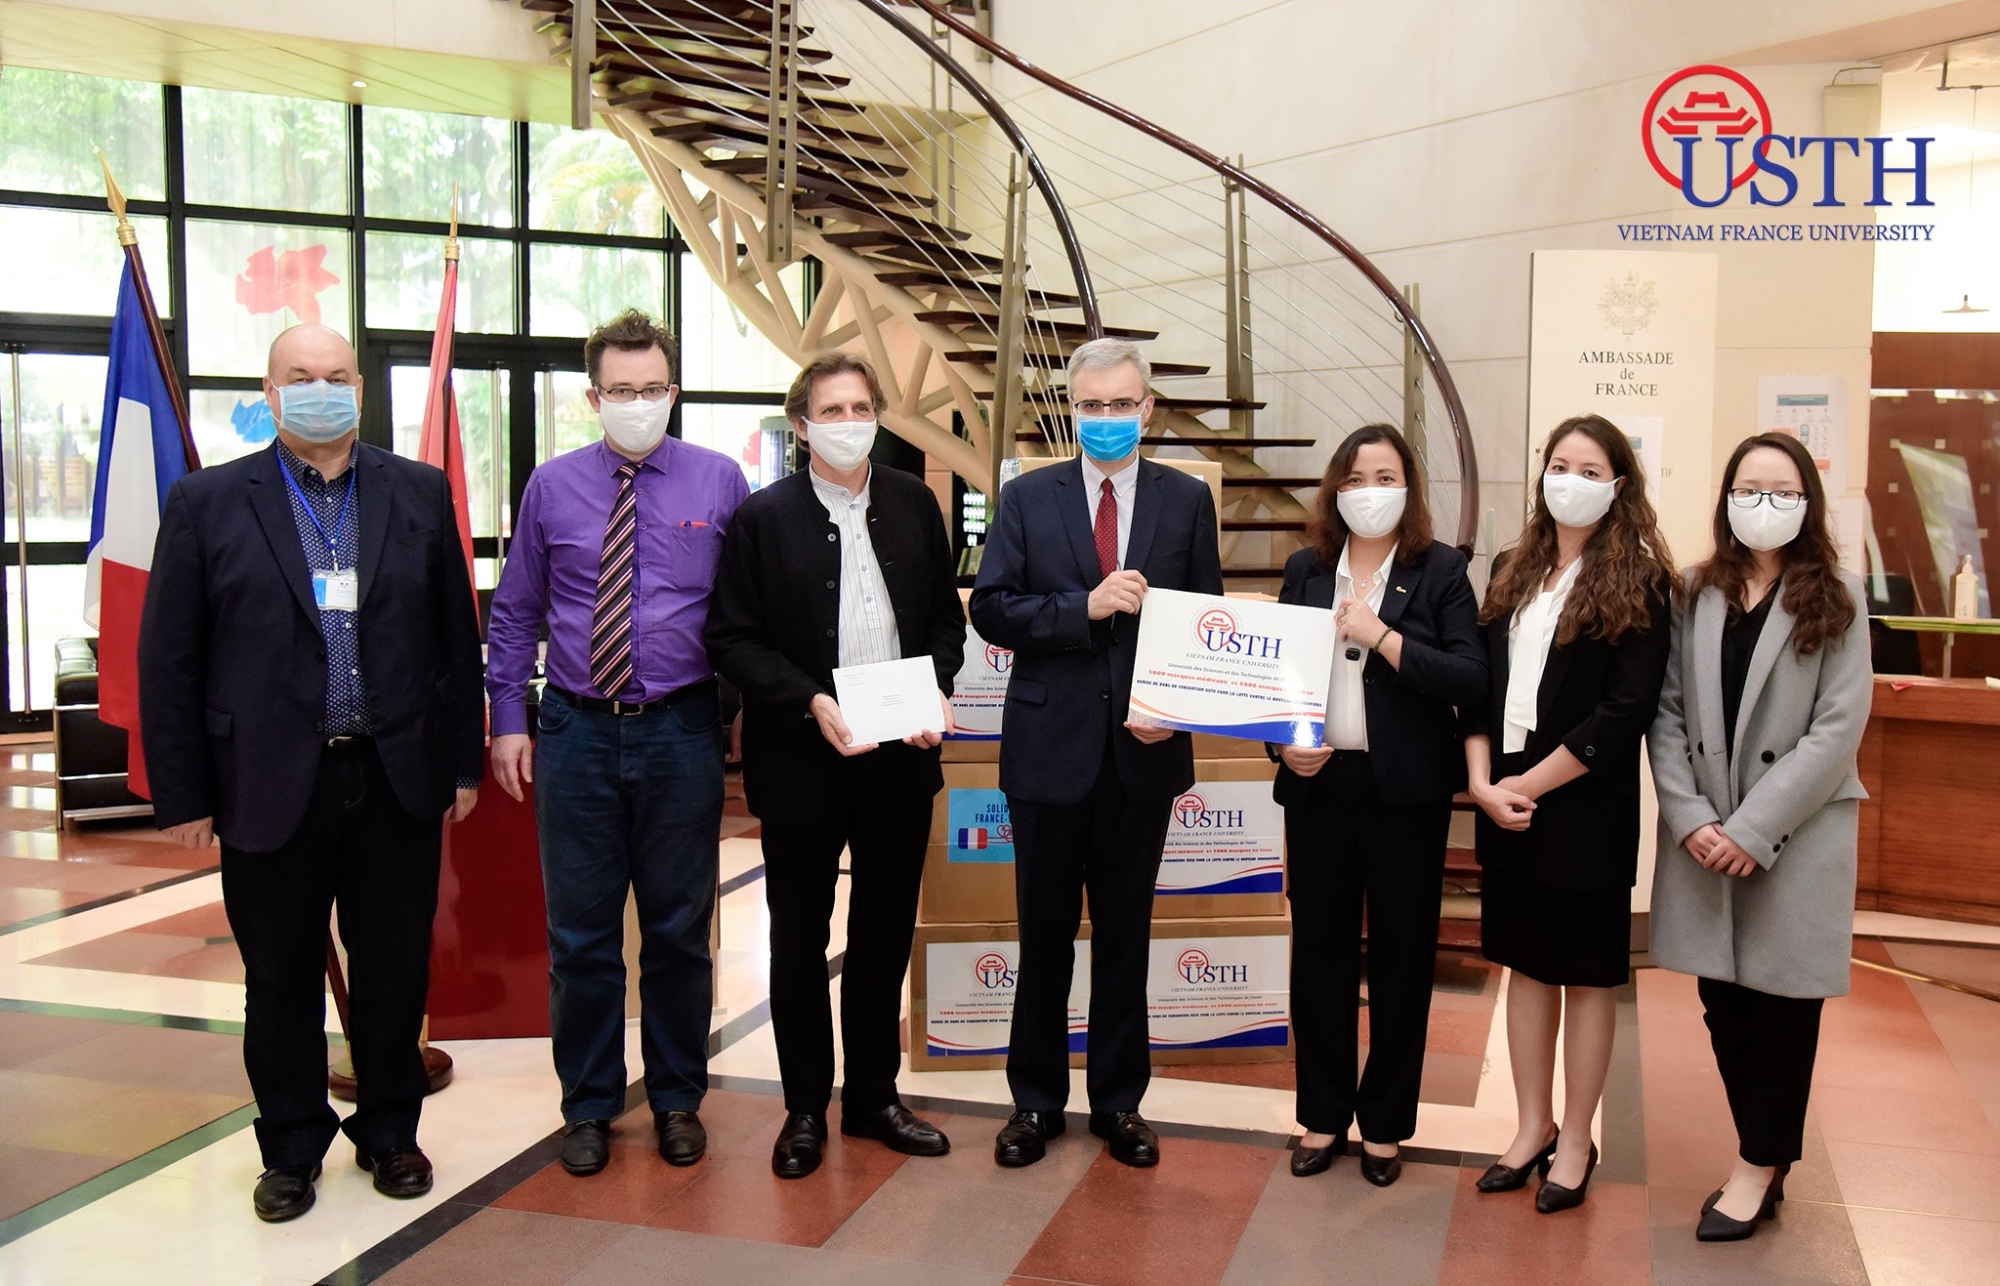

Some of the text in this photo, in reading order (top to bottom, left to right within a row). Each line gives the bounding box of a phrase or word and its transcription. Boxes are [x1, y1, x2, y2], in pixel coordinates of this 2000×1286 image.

[1579, 351, 1674, 365] AMBASSADE
[1620, 368, 1635, 380] de
[1595, 383, 1658, 396] FRANCE
[1207, 630, 1283, 659] USTH
[1185, 653, 1280, 669] VIETNAM FRANCE UNIVERSITY
[1168, 662, 1193, 670] Université
[1240, 672, 1272, 682] Technologies
[1167, 672, 1195, 680] masques
[1196, 675, 1228, 684] médicaux
[1258, 683, 1285, 692] masque
[975, 813, 1010, 823] FRANCE-
[1183, 810, 1244, 828] USTH
[984, 970, 1018, 989] US
[1186, 965, 1248, 984] USTH
